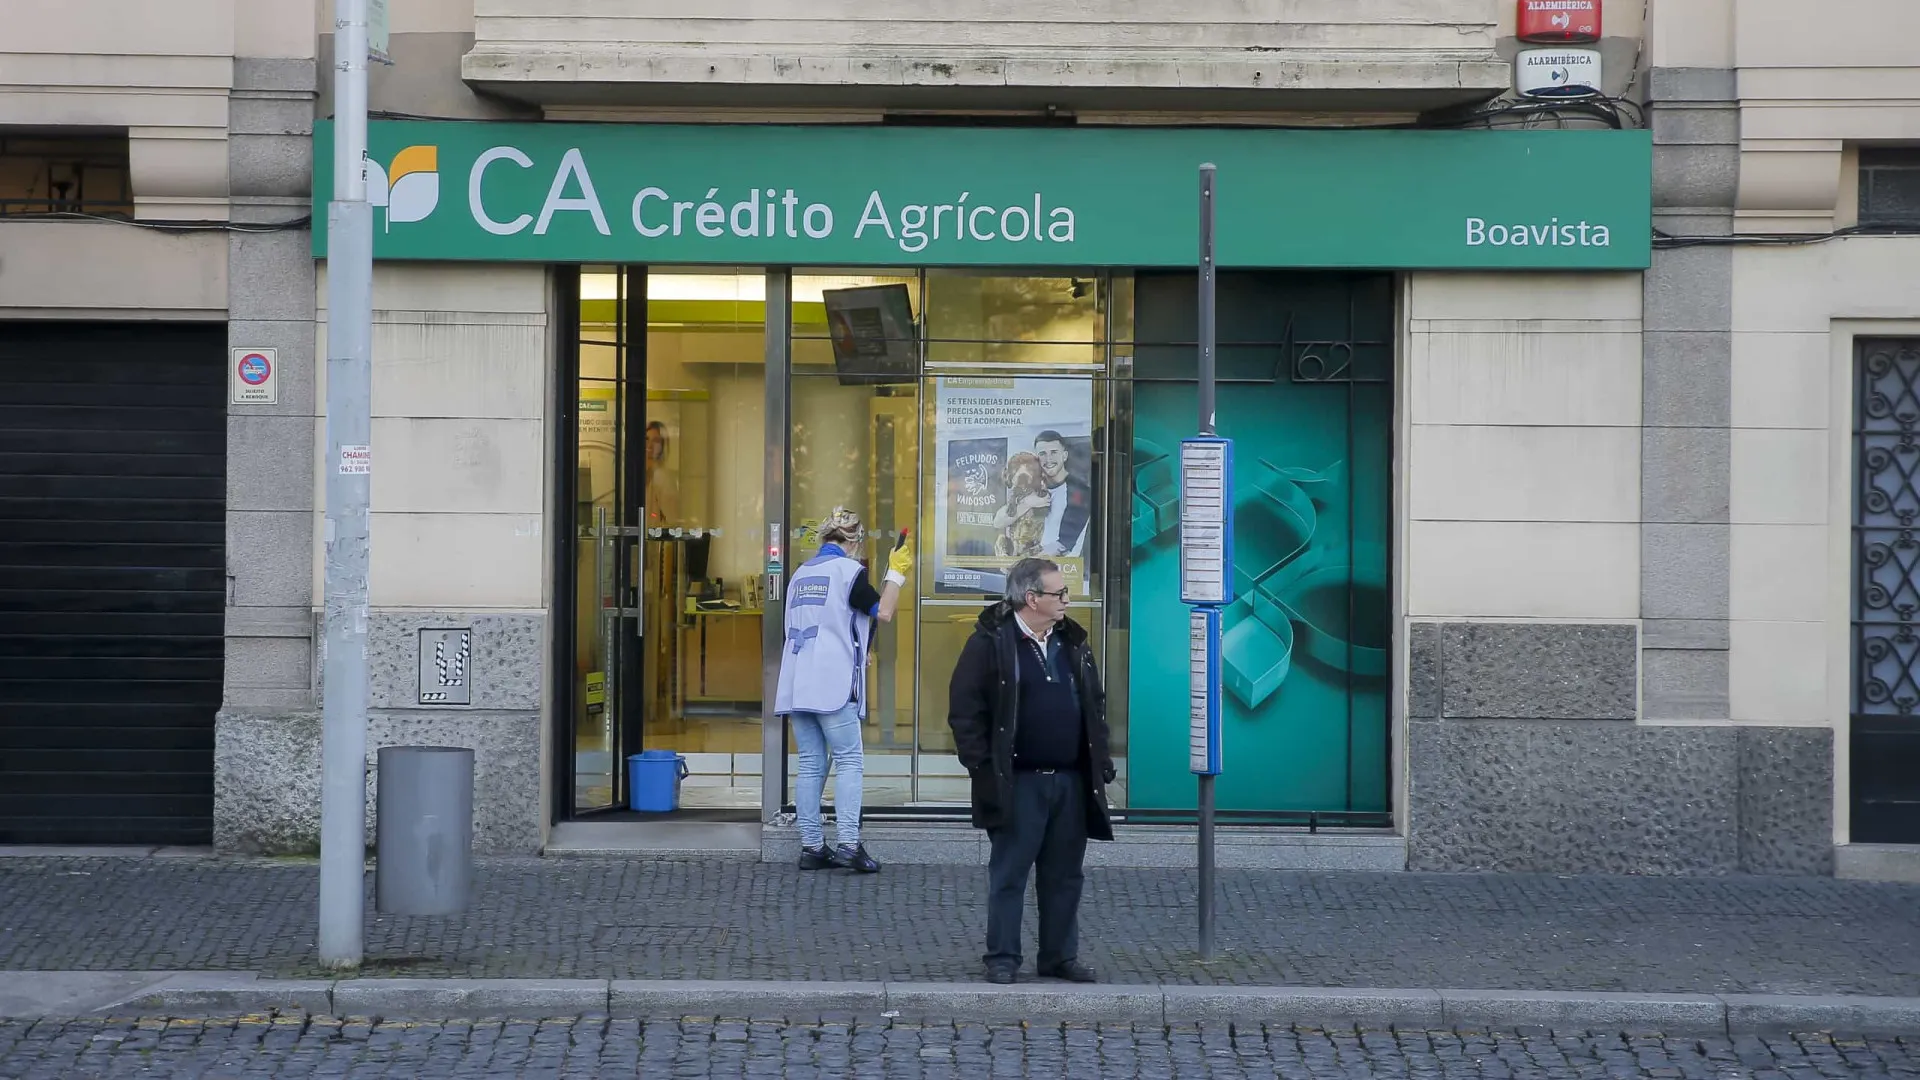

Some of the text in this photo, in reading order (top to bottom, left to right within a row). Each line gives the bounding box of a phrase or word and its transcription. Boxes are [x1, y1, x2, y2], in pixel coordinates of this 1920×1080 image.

[1527, 54, 1592, 66] ALARMIBÉRICA
[468, 146, 1075, 253] CA Crédito Agrícola
[1466, 217, 1610, 247] Boavista
[974, 417, 1023, 425] ACOMPANHA.
[956, 453, 998, 471] FELPUDOS
[957, 494, 996, 506] VAIDOSOS
[1063, 563, 1078, 574] CA
